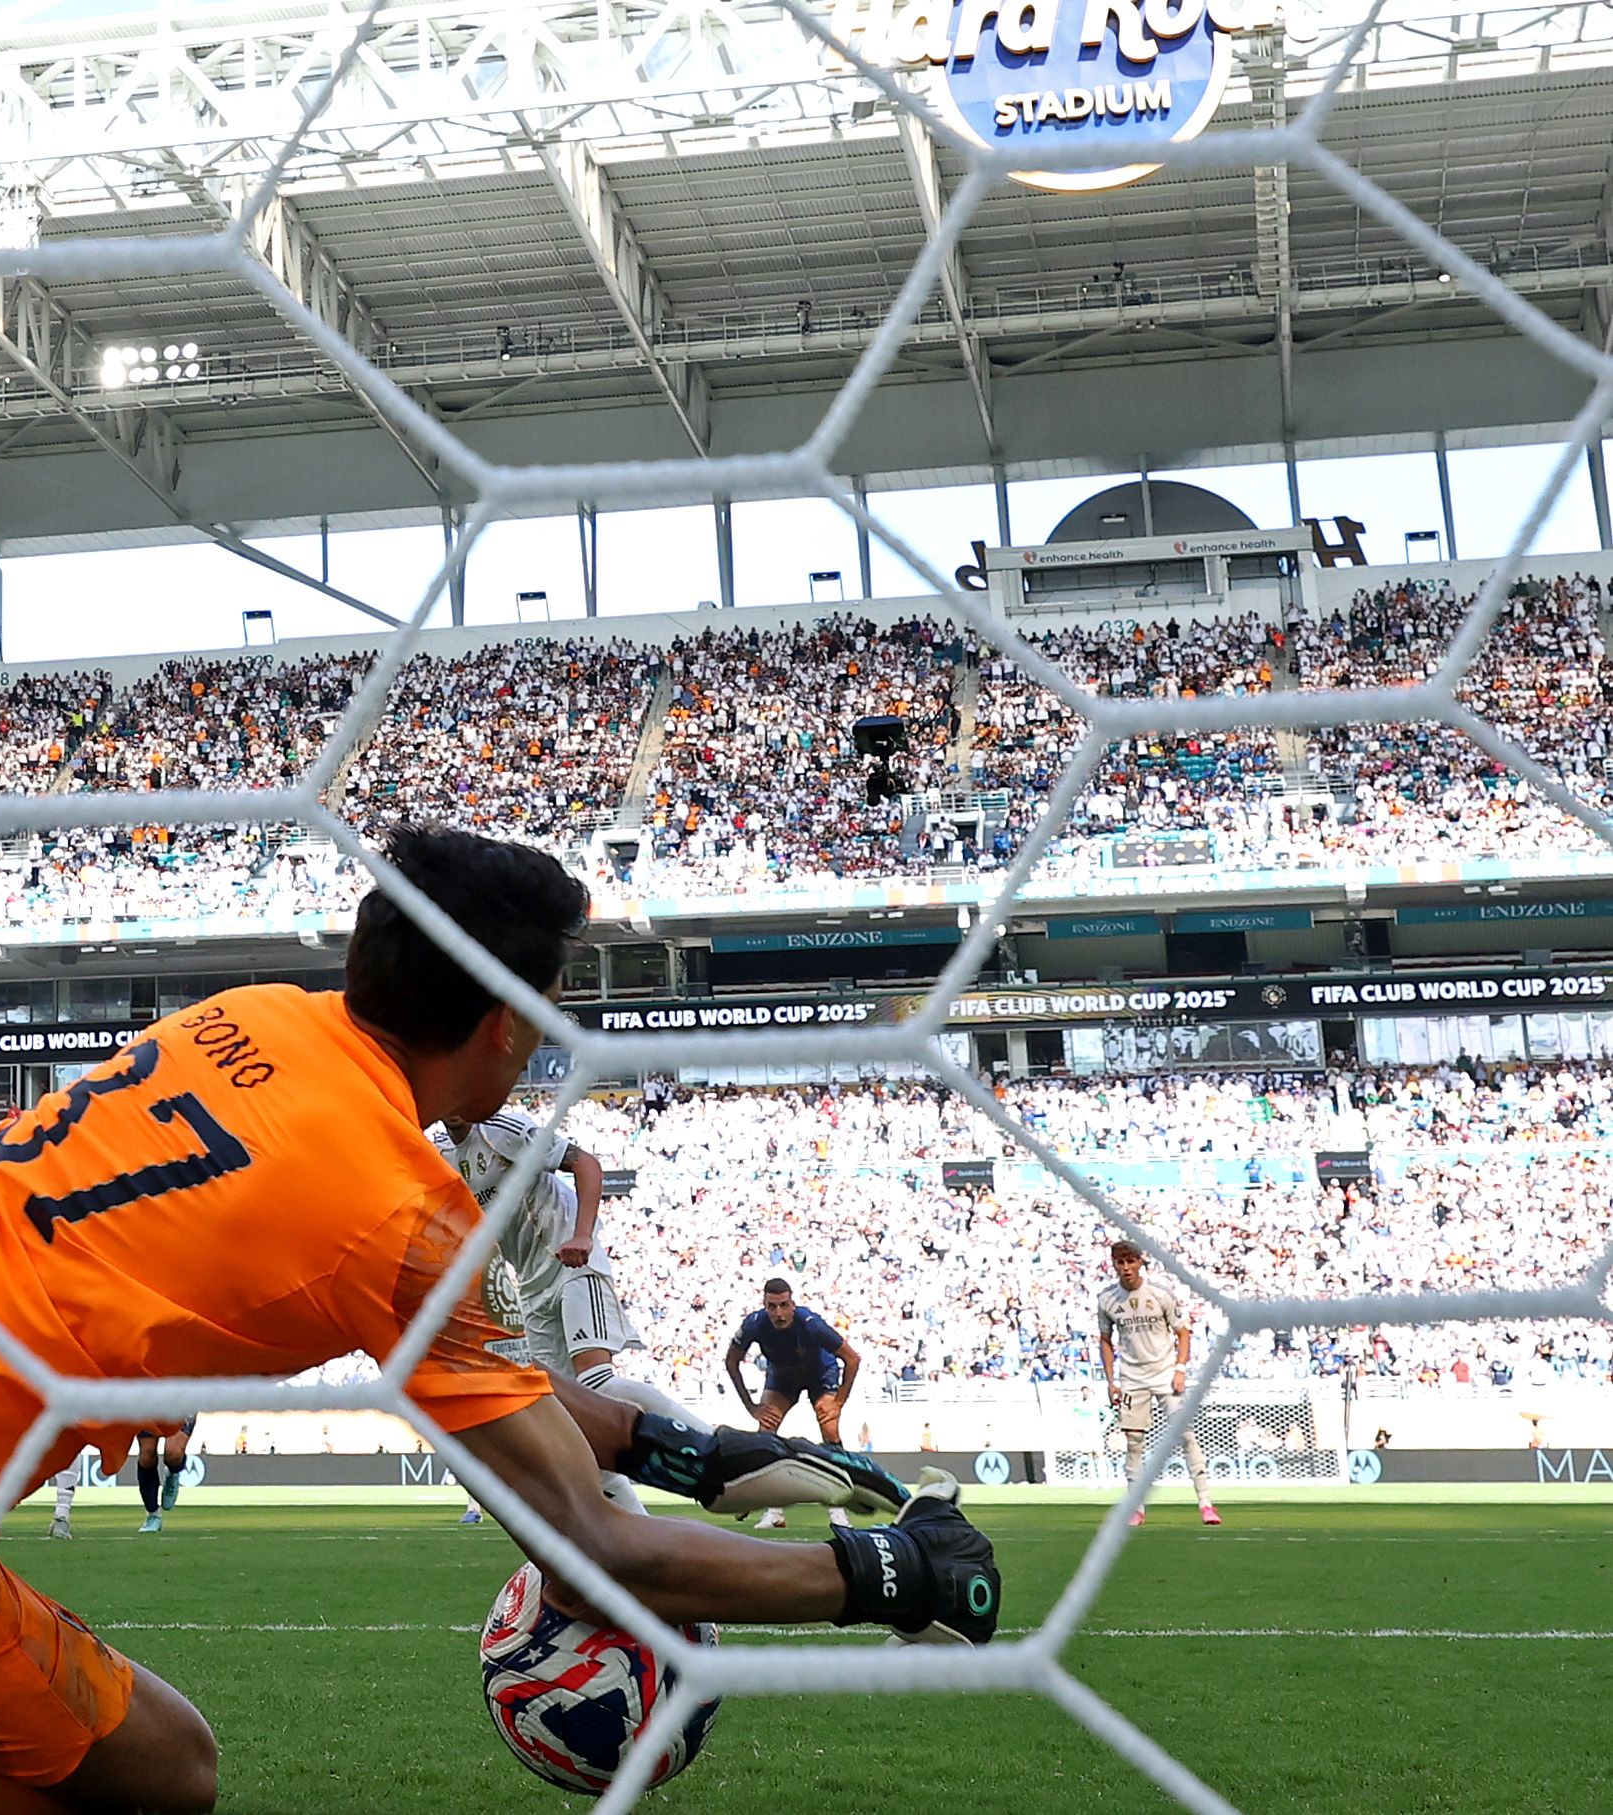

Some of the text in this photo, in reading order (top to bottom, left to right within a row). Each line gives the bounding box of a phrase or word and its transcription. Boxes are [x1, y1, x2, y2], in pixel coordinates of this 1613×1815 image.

[994, 79, 1171, 128] STADIUM
[1039, 550, 1124, 564] enhance health
[1189, 539, 1276, 554] enhance health
[1480, 903, 1585, 919] ENDZONE
[1072, 921, 1135, 934] ENDZONE
[1210, 916, 1275, 928] ENDZONE
[788, 931, 883, 947] ENDZONE
[1311, 986, 1359, 1004] FIFA
[1360, 984, 1416, 1003] CLUB
[1421, 982, 1498, 1000] WORLD
[1502, 979, 1546, 997] CUP
[949, 998, 991, 1017] FIFA
[994, 996, 1046, 1015] CLUB
[1050, 993, 1125, 1014] WORLD
[1129, 992, 1170, 1011] CUP
[602, 1013, 643, 1029] FIFA
[646, 1009, 696, 1028] CLUB
[699, 1007, 771, 1027] WORLD
[774, 1005, 814, 1023] CUP
[0, 1034, 45, 1051] CLUB
[48, 1032, 113, 1049] WORLD
[115, 1030, 143, 1047] CU
[182, 1006, 274, 1088] BONO
[870, 1533, 898, 1599] ISAAC
